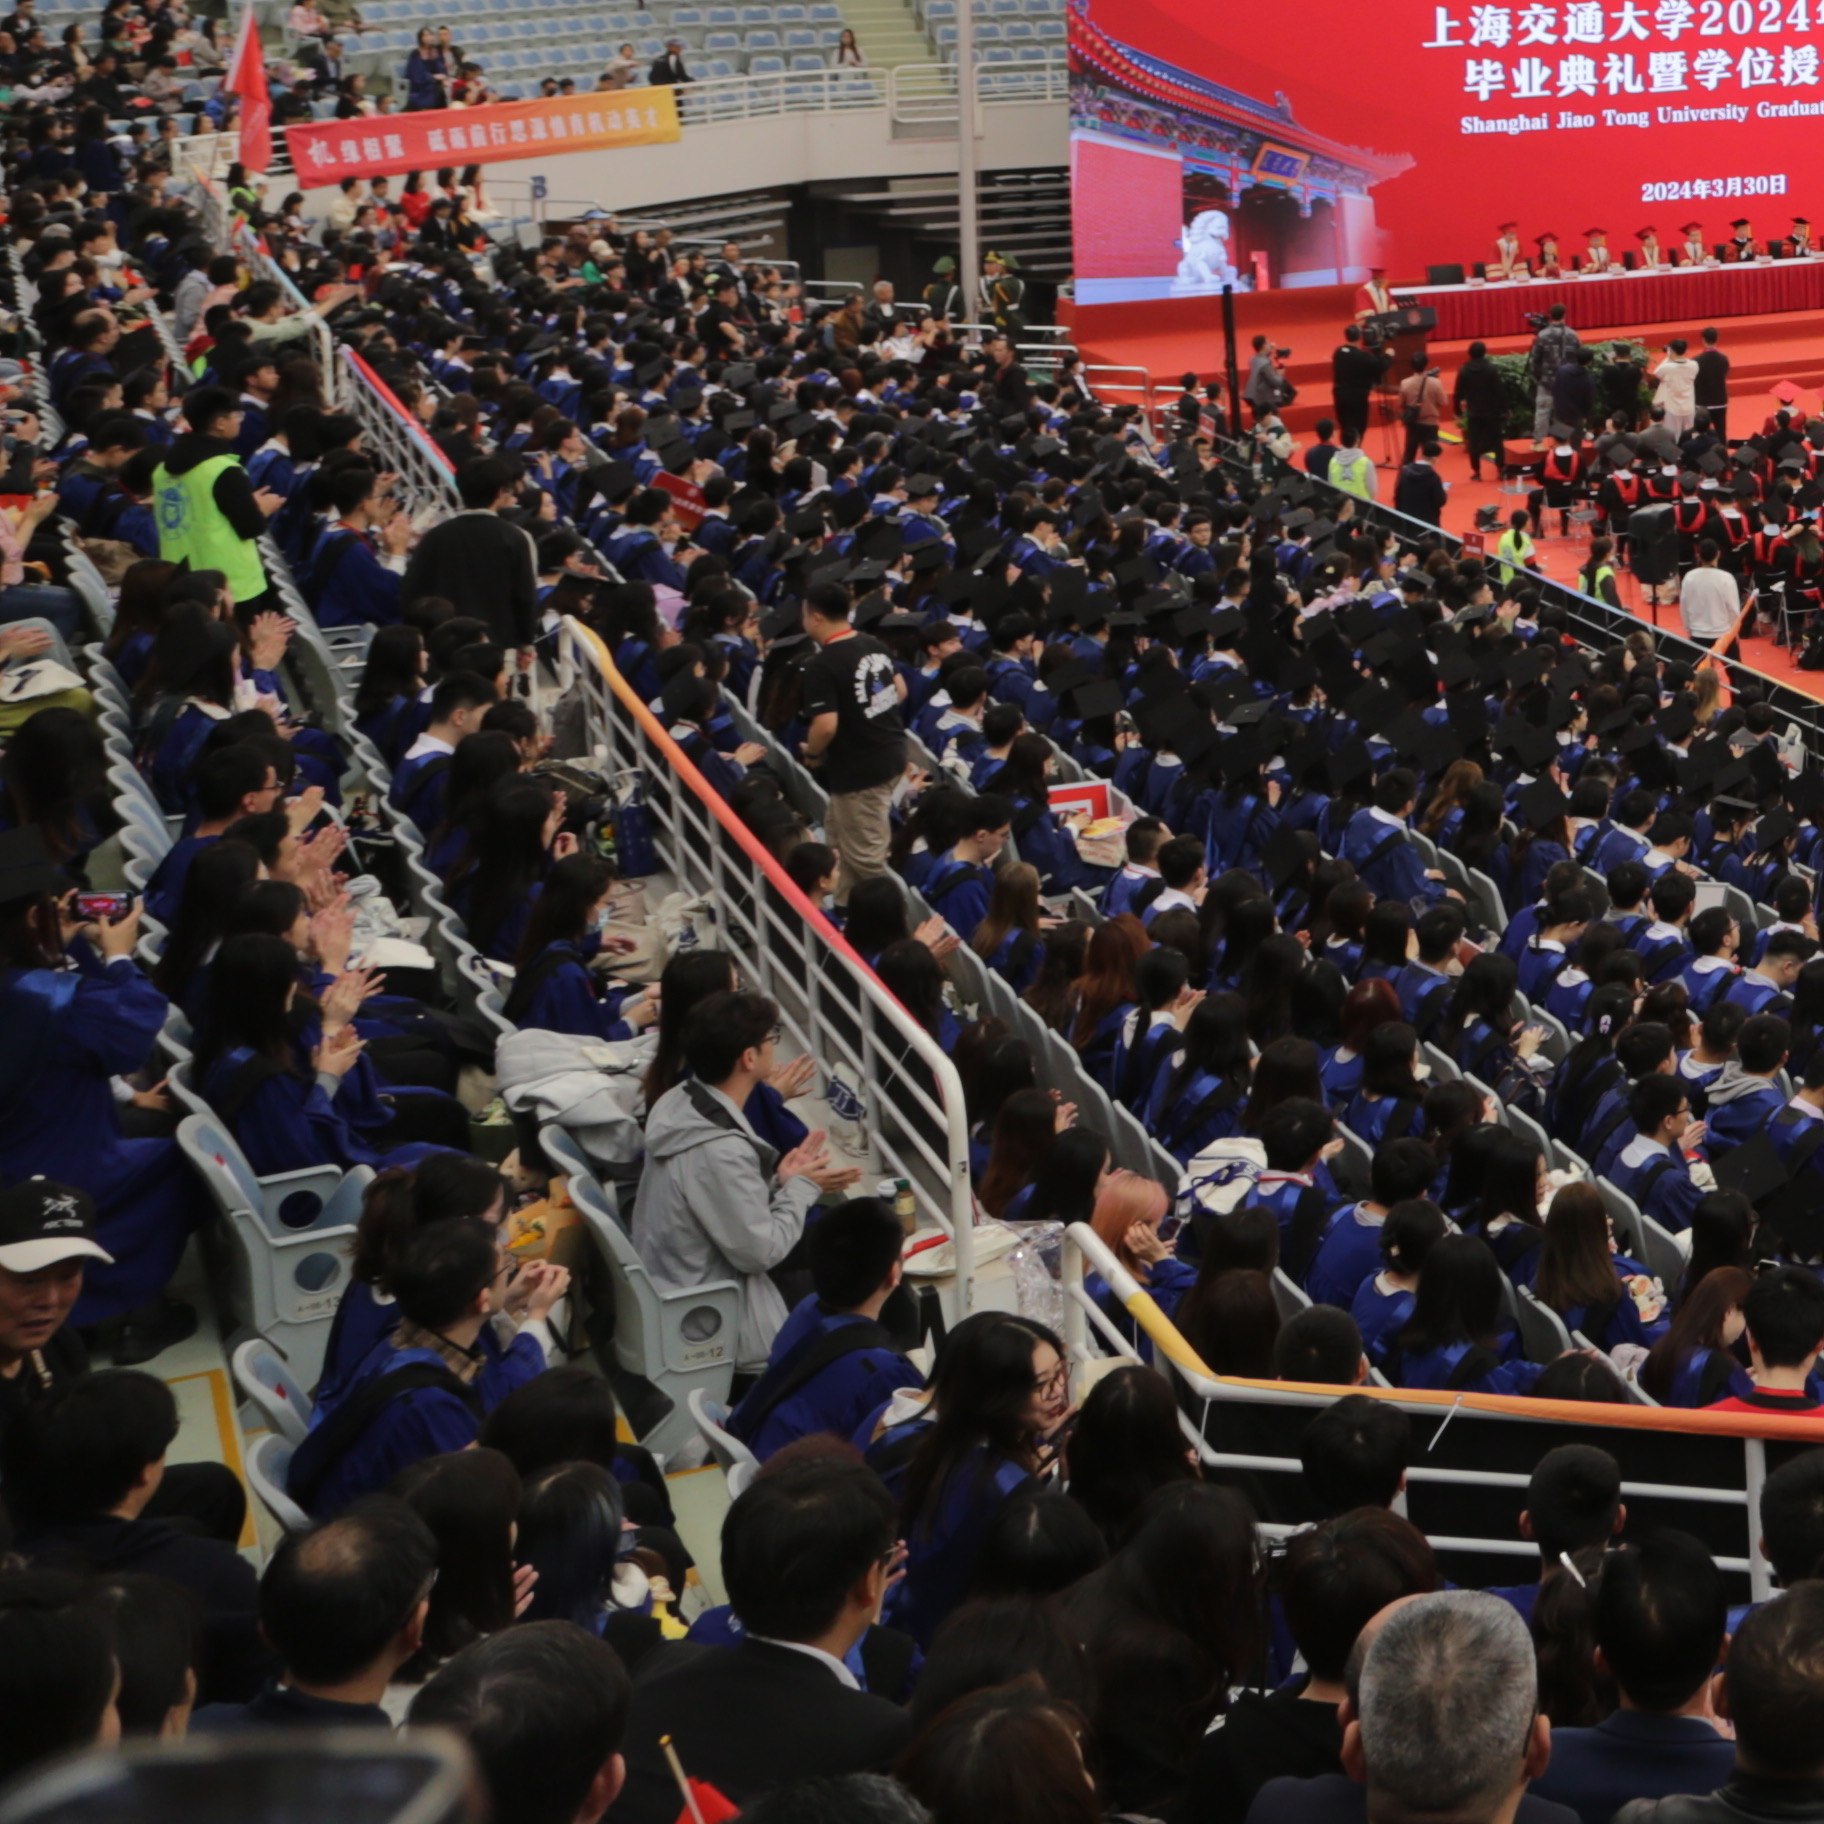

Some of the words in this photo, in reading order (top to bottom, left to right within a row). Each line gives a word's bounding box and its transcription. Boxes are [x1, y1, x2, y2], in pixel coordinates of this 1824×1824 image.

[1461, 111, 1551, 137] Shanghai
[1556, 109, 1593, 131] Jiao
[1602, 108, 1650, 131] Tong
[1656, 104, 1748, 129] University
[1642, 174, 1788, 204] 2024年3月30日
